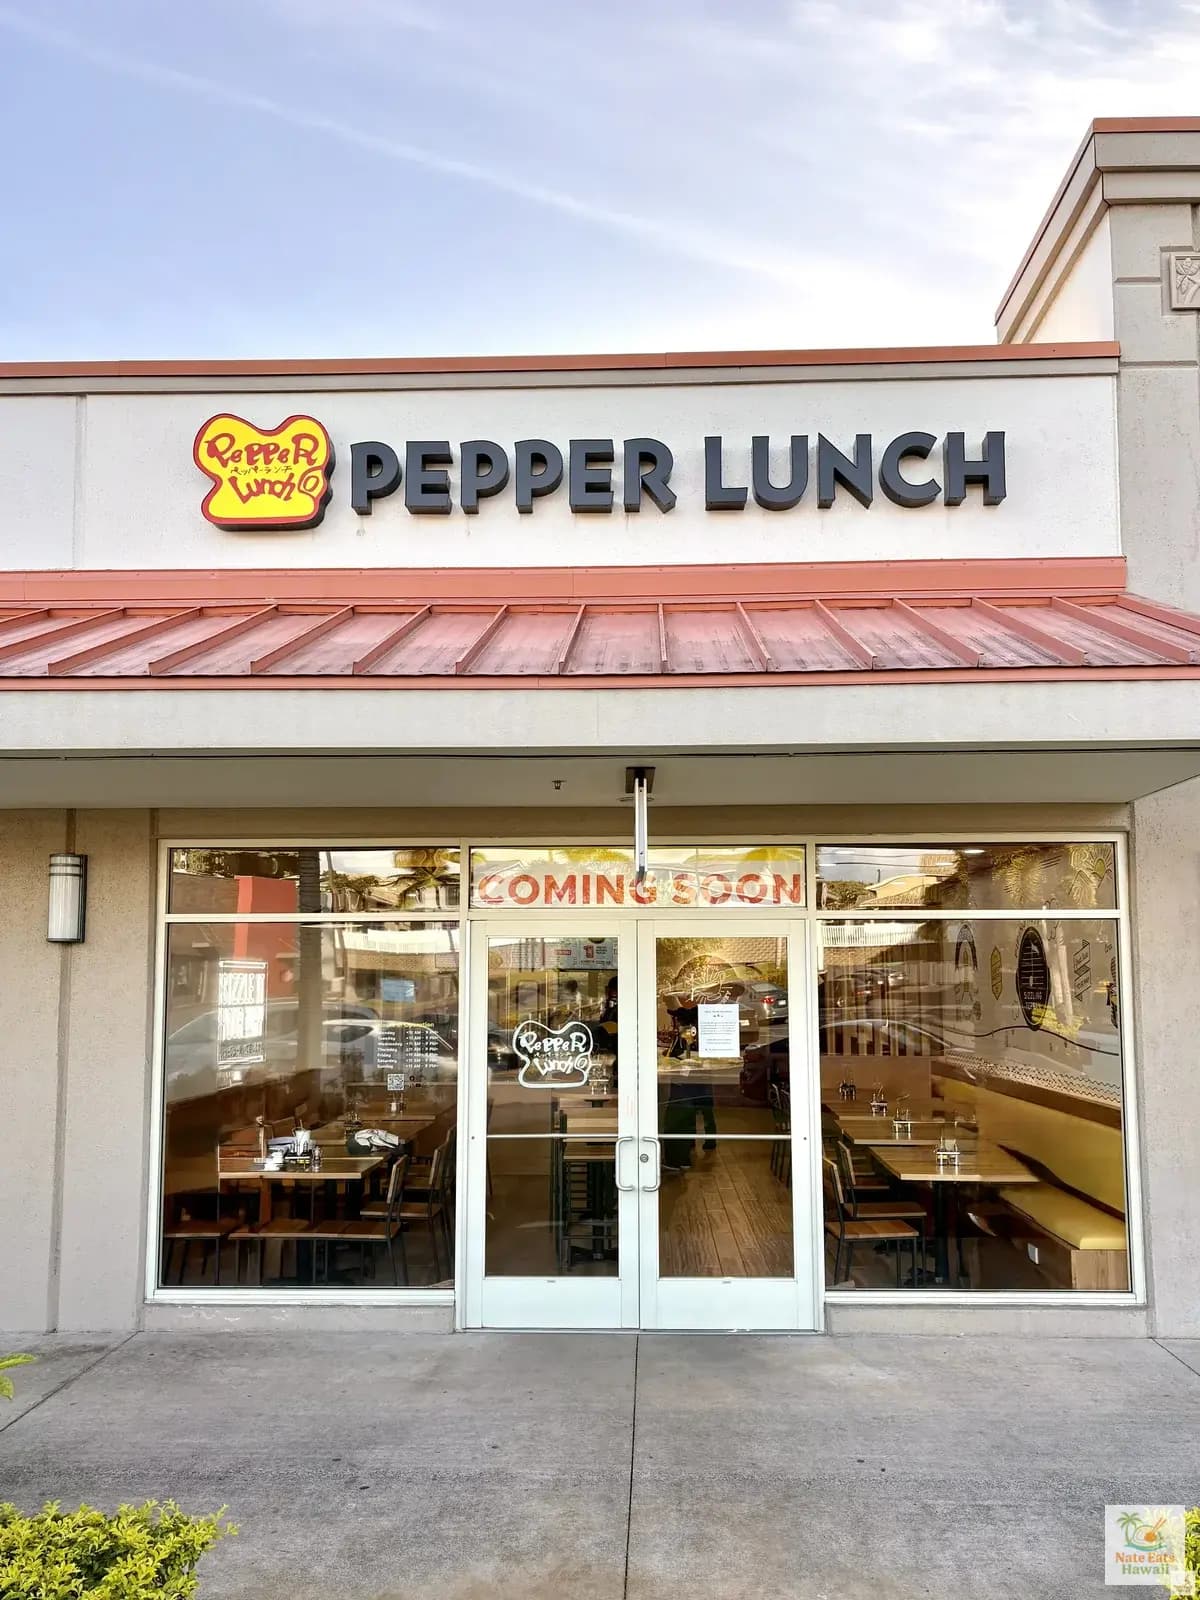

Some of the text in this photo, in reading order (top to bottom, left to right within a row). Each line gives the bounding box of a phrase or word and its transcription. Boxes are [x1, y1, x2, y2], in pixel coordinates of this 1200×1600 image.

[351, 431, 1006, 515] PEPPER LUNCH
[478, 873, 801, 905] COMING SOON
